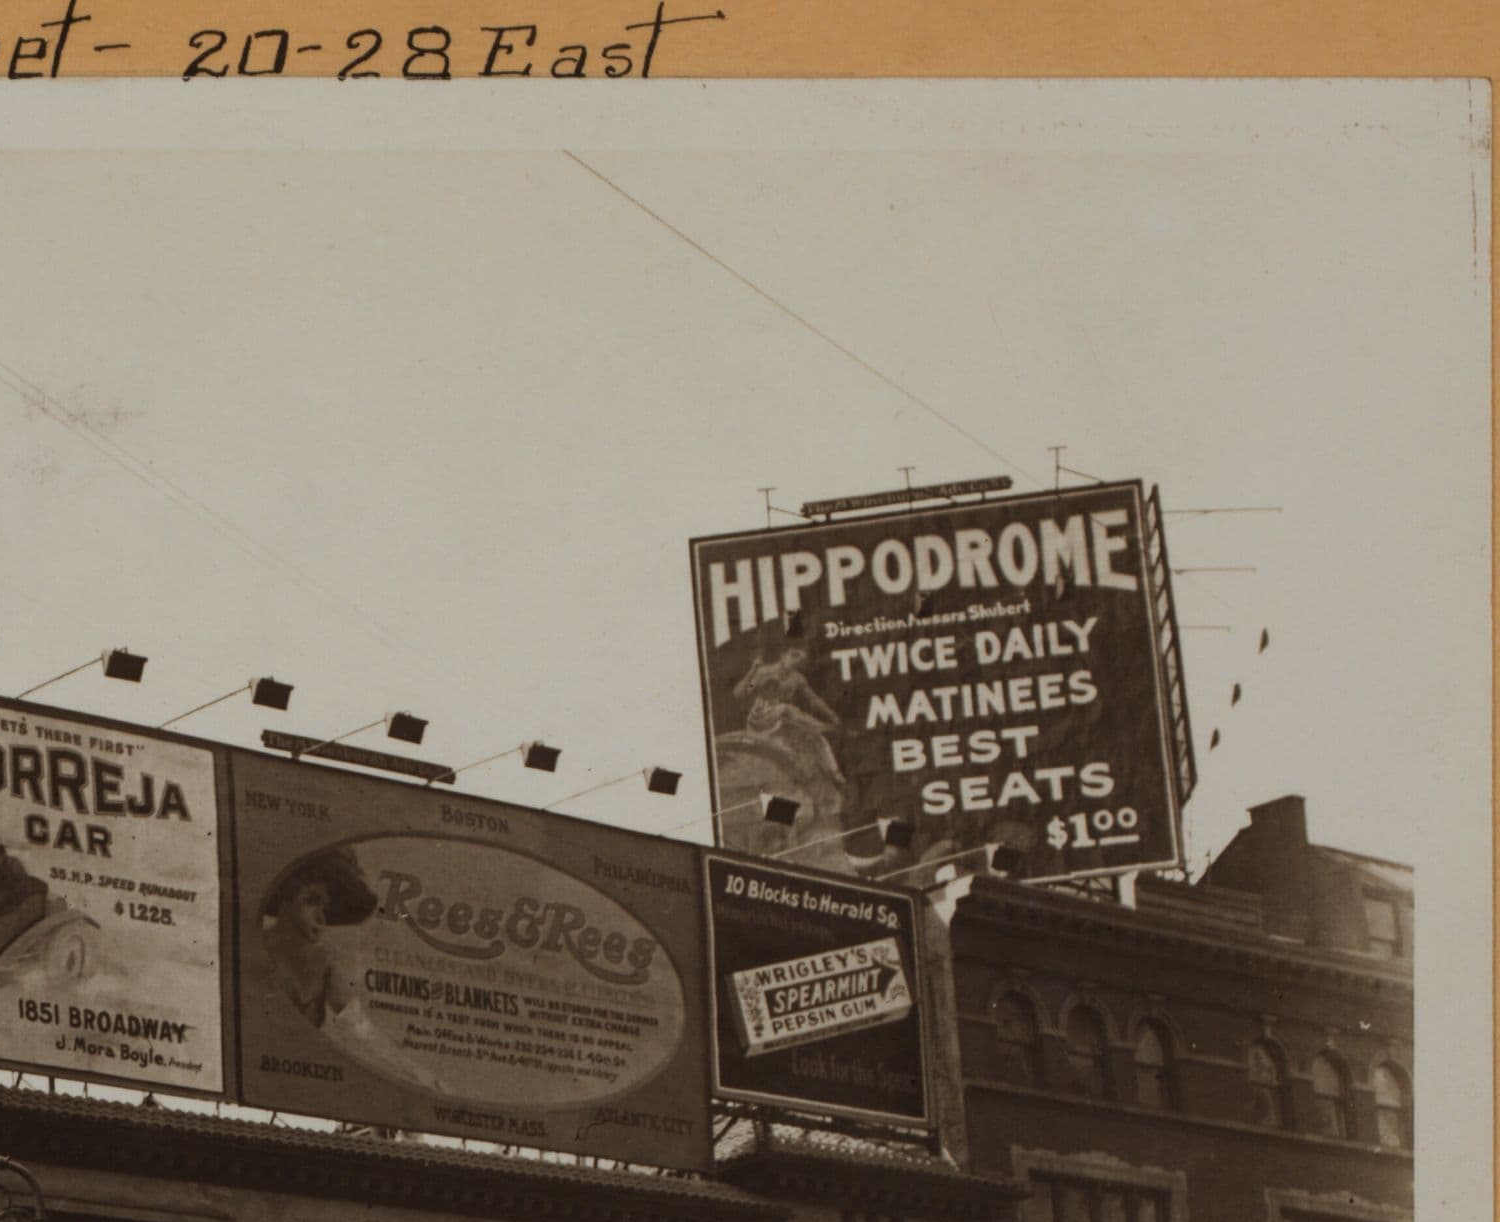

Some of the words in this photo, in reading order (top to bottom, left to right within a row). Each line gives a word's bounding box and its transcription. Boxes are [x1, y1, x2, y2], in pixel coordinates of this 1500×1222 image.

[183, 24, 453, 82] 20-28
[476, 8, 728, 80] East
[709, 509, 1138, 648] HIPPODROME
[825, 616, 906, 638] Direction
[831, 636, 959, 681] TWICE
[975, 617, 1099, 664] DAILY
[866, 670, 1098, 729] MATINEES
[35, 726, 82, 747] THERE
[892, 726, 1040, 772] BEST
[922, 763, 1115, 814] SEATS
[245, 790, 285, 811] NEW
[286, 798, 331, 823] YORK
[440, 805, 510, 834] BOSTON
[24, 813, 113, 858] CAR
[98, 875, 136, 892] SPEED
[138, 882, 197, 903] RUNABOUT
[593, 856, 692, 895] PHILADELPHIA
[723, 873, 746, 897] 10
[746, 878, 801, 909] Blocks
[802, 890, 818, 910] to
[819, 894, 874, 921] Herald
[378, 870, 506, 960] Rees
[506, 896, 544, 948] &
[540, 901, 659, 986] Rees
[755, 945, 869, 989] WRIGLEY'S
[364, 968, 430, 1001] CURTAINS
[444, 982, 520, 1017] BLANKETS
[771, 966, 883, 1016] SPEARMINT
[18, 997, 61, 1026] 1851
[68, 1006, 189, 1044] BROADWAY
[771, 1007, 837, 1036] PEPSIN
[841, 998, 878, 1020] GUM
[56, 1035, 73, 1052] J.
[73, 1037, 116, 1060] Mora
[260, 1055, 344, 1083] BROOKLYN
